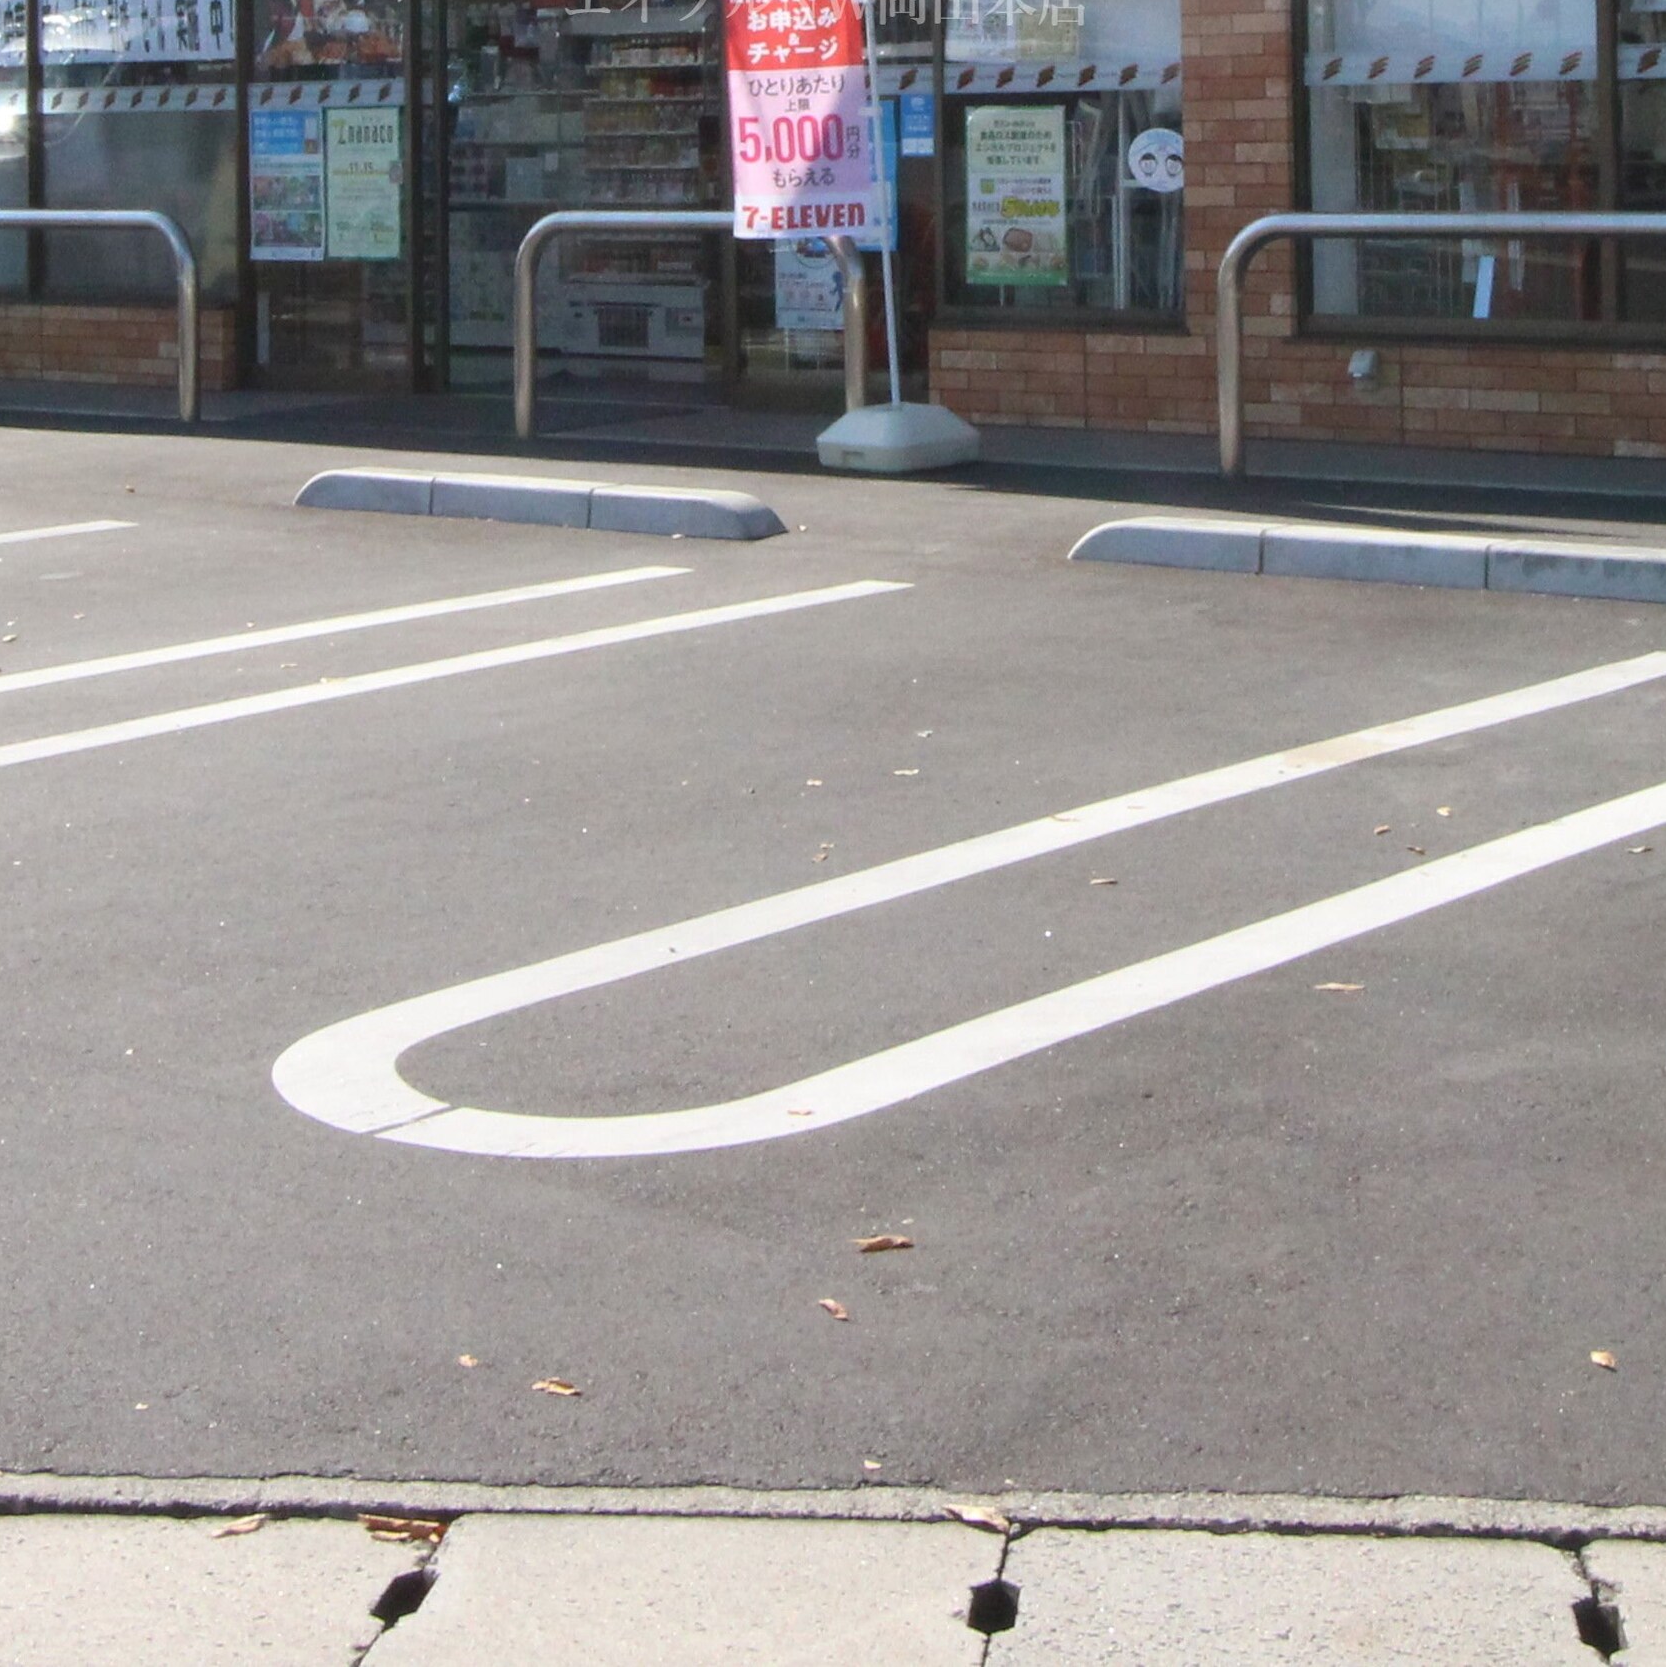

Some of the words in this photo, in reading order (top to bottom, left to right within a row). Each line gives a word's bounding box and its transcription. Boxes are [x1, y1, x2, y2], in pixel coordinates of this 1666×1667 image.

[747, 6, 837, 32] お申込み
[747, 37, 839, 64] チャージ
[748, 74, 846, 97] ひとりあたり
[784, 99, 811, 113] 上限
[738, 113, 844, 164] 5,000
[772, 166, 836, 188] もらえる
